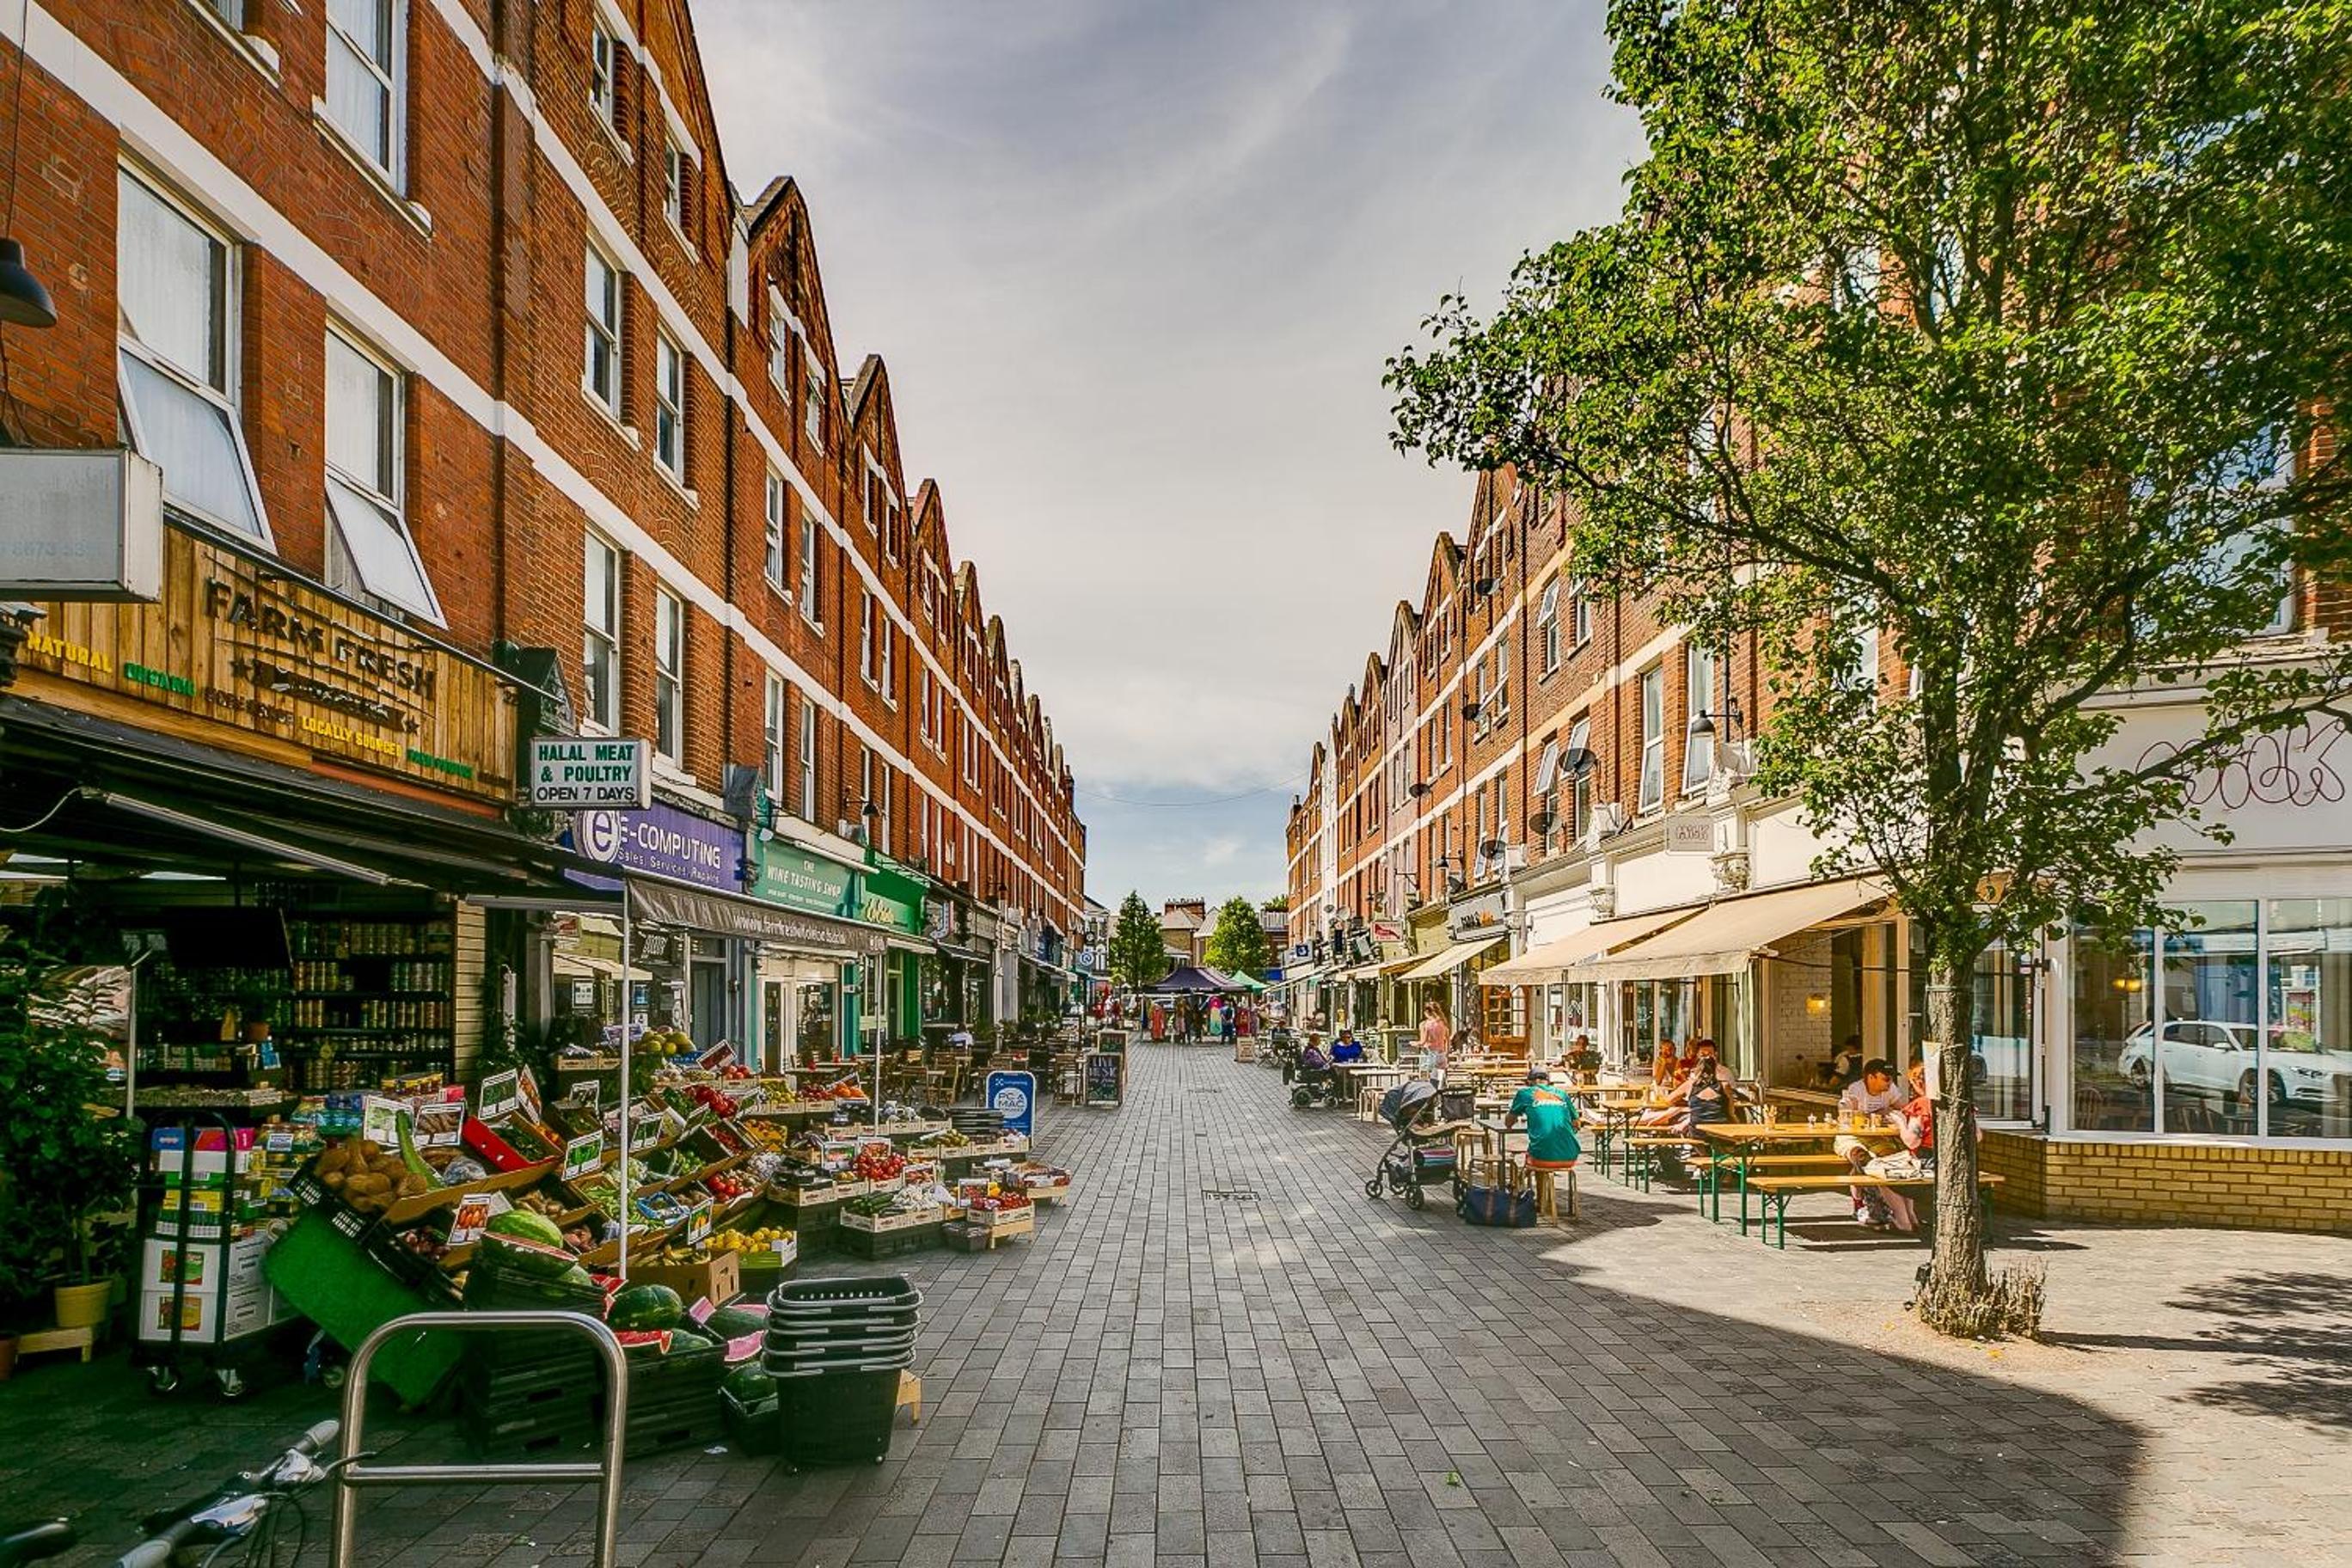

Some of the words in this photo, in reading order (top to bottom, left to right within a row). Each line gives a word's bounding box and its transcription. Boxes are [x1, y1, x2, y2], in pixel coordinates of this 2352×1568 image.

[206, 576, 326, 652] FARM
[334, 635, 438, 701] FRESH
[27, 630, 113, 673] NATURAL
[301, 714, 354, 743] LOCALLY
[538, 744, 587, 761] HALAL
[595, 744, 634, 761] MEAT
[541, 766, 553, 782] &
[564, 766, 632, 782] POULTRY
[536, 787, 579, 800] OPEN
[583, 787, 591, 800] 7
[597, 787, 635, 801] DAYS
[791, 873, 822, 893] TASTING
